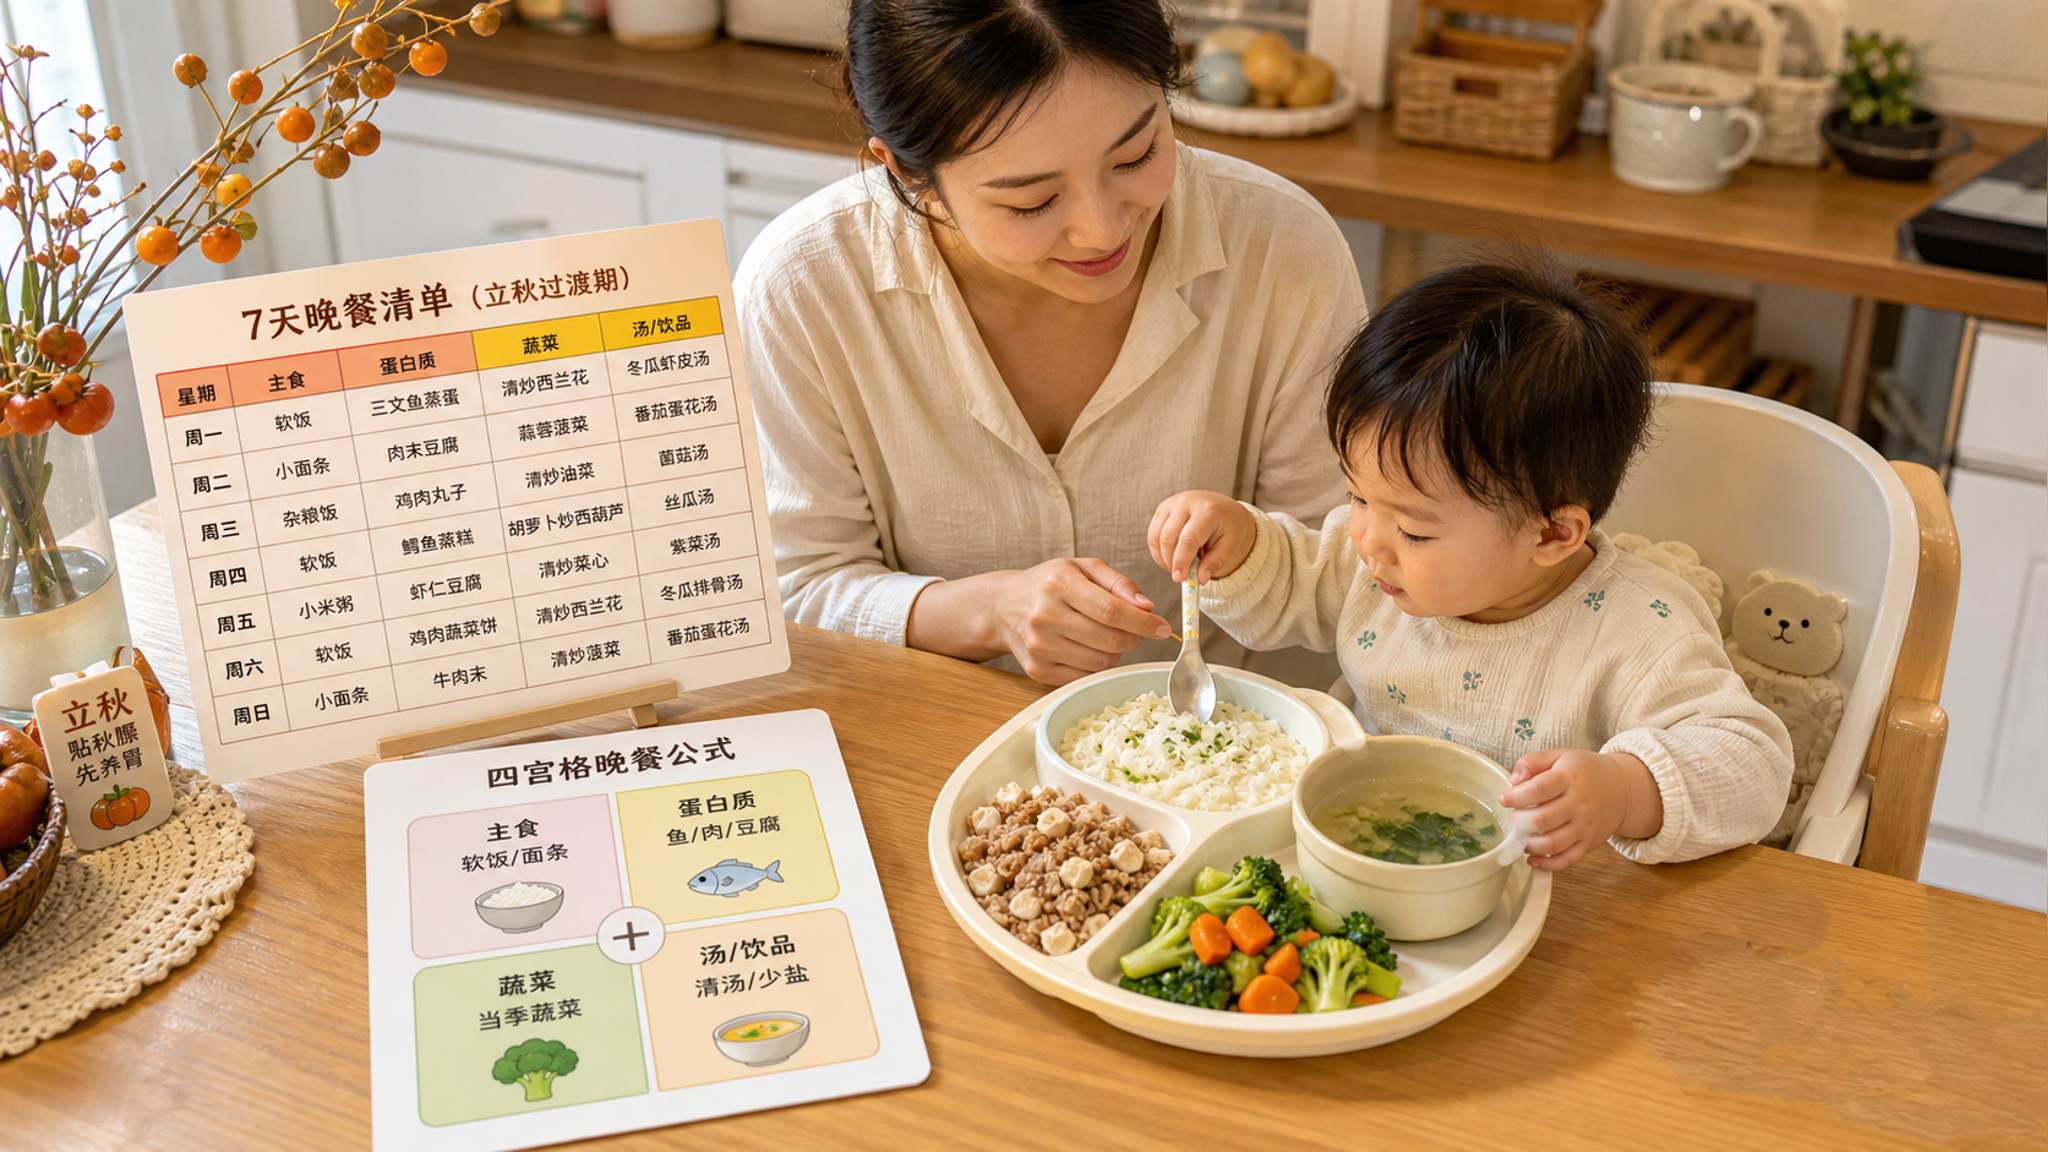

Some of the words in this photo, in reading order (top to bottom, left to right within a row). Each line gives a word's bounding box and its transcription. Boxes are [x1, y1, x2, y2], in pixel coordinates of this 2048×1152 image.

[242, 283, 452, 340] 7天晚餐清单
[633, 315, 691, 338] 汤/饮品
[522, 334, 559, 354] 蔬菜
[380, 351, 436, 375] 蛋白质
[627, 350, 709, 376] 冬瓜虾皮汤
[268, 371, 305, 392] 主食
[501, 367, 589, 397] 清炒西兰花
[179, 384, 216, 406] 星期
[371, 388, 459, 416] 三文鱼蒸蛋
[635, 395, 716, 422] 番茄蛋花汤
[275, 411, 312, 432] 软饭
[186, 429, 222, 447] 周一
[388, 436, 458, 462] 肉末豆腐
[658, 444, 708, 466] 菌菇汤
[276, 457, 330, 480] 小面条
[526, 462, 594, 488] 清炒油菜
[193, 474, 231, 494] 周二
[395, 484, 466, 509] 鸡肉丸子
[665, 488, 714, 511] 丝瓜汤
[283, 504, 338, 527] 杂粮饭
[508, 503, 623, 536] 胡萝卜炒西葫芦
[202, 521, 239, 541] 周三
[670, 533, 720, 555] 紫菜汤
[300, 551, 337, 573] 软饭
[539, 553, 609, 578] 清炒菜心
[210, 567, 247, 588] 周四
[410, 574, 481, 600] 虾仁豆腐
[661, 574, 742, 601] 冬瓜排骨汤
[300, 595, 353, 619] 小米粥
[536, 594, 623, 624] 清炒西兰花
[218, 613, 256, 634] 周五
[410, 617, 497, 646] 鸡肉蔬菜饼
[667, 618, 749, 646] 番茄蛋花汤
[315, 642, 353, 663] 软饭
[551, 640, 621, 668] 清炒菠菜
[226, 659, 263, 680] 周六
[434, 665, 487, 688] 牛肉末
[61, 688, 133, 733] 立秋
[315, 687, 369, 710] 小面条
[234, 704, 270, 725] 周日
[488, 737, 735, 788] 四宫格晚餐公式
[679, 791, 756, 817] 蛋白质
[487, 819, 538, 842] 主食
[666, 816, 780, 846] 鱼/肉/豆腐
[462, 844, 568, 872] 软饭/面条
[700, 935, 795, 965] 汤/饮品
[499, 970, 555, 996] 蔬菜
[696, 964, 809, 997] 清汤/少盐
[480, 998, 581, 1030] 当季蔬菜
